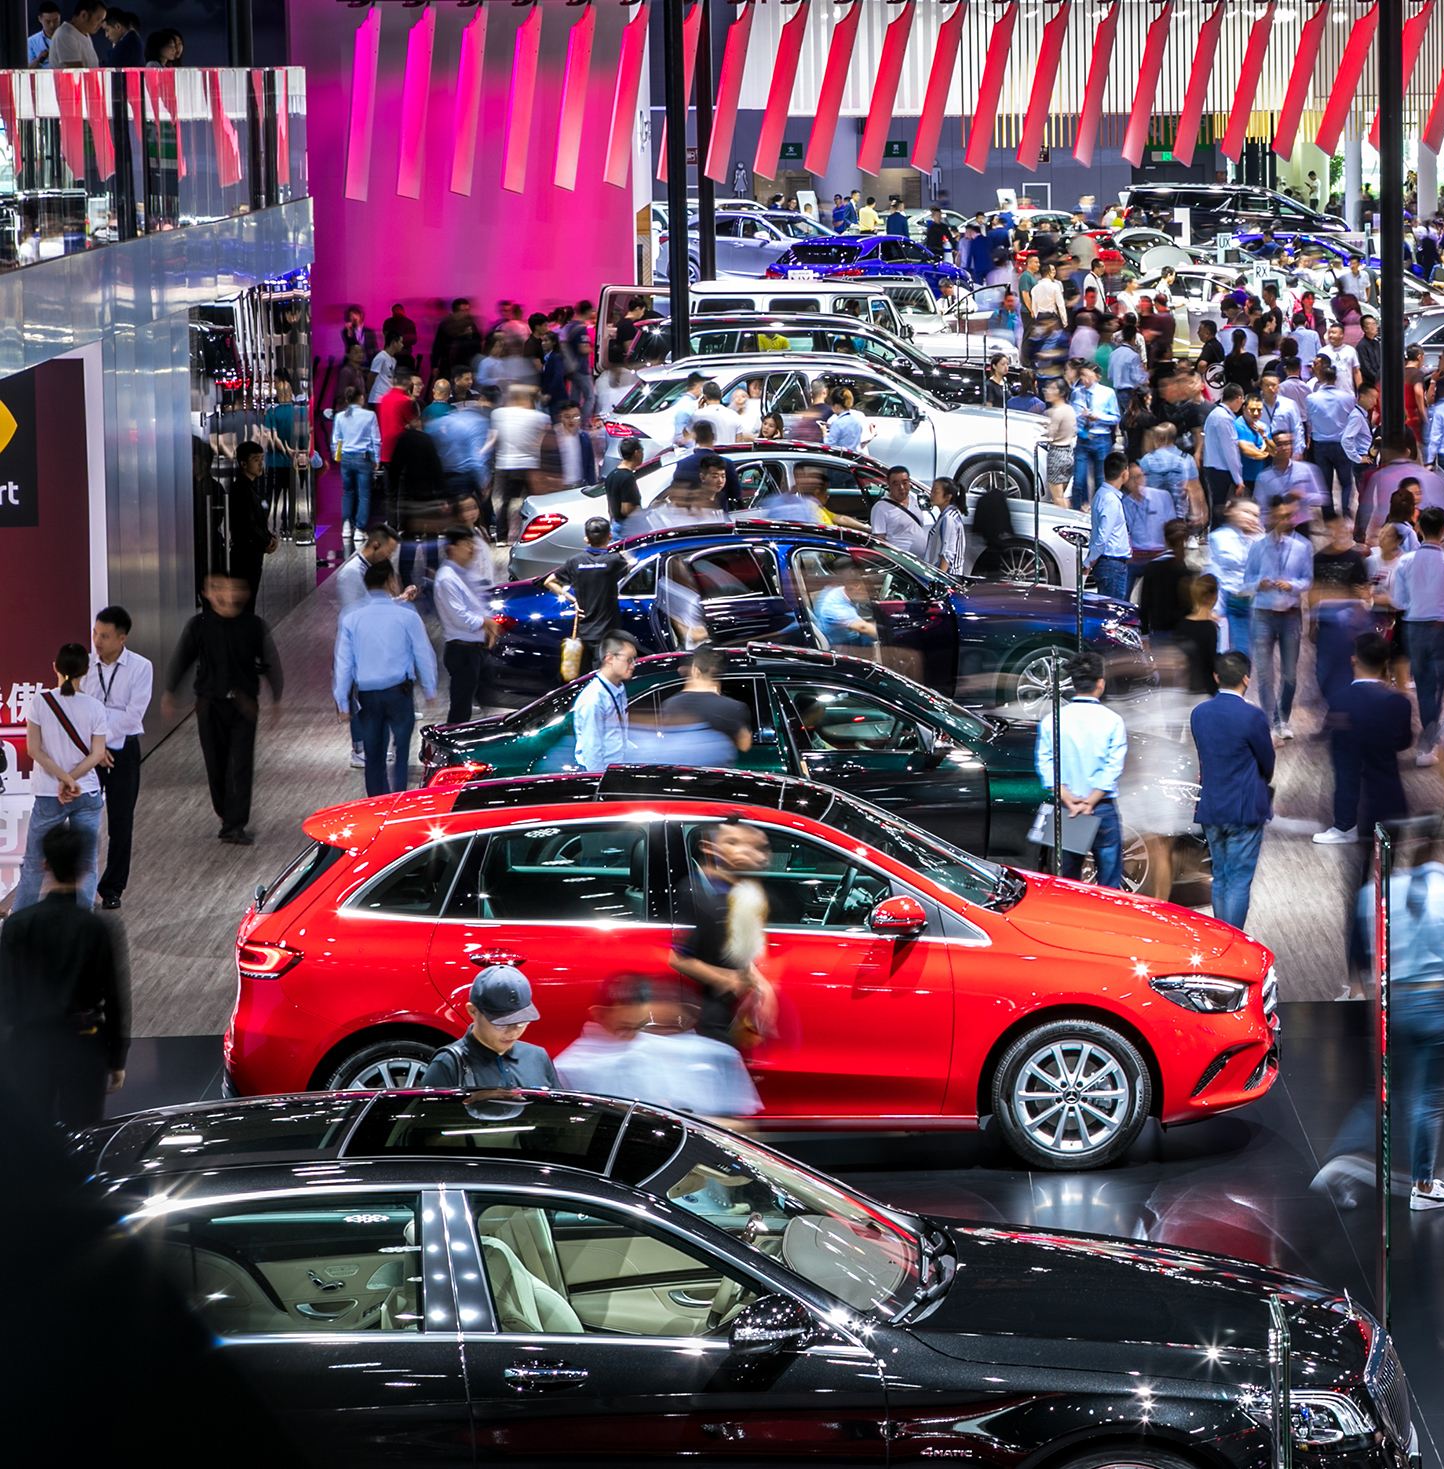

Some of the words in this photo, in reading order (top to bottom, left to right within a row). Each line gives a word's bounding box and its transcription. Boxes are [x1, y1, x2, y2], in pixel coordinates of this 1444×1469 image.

[1219, 238, 1230, 248] UX
[1255, 265, 1267, 278] RX
[920, 1447, 972, 1457] 4MATIC
